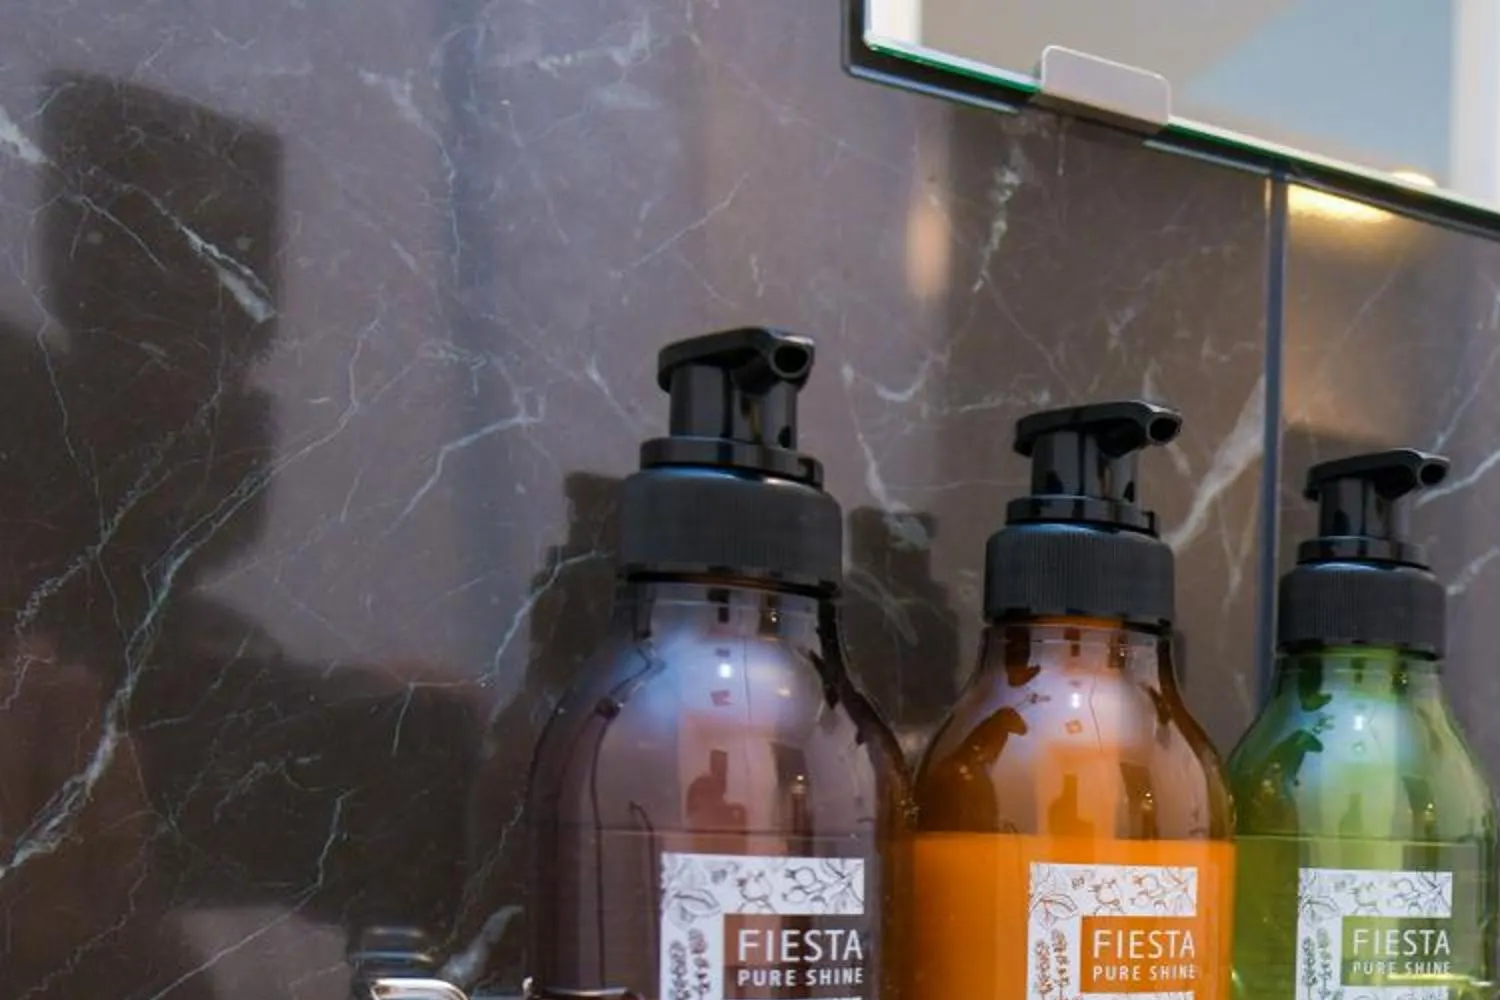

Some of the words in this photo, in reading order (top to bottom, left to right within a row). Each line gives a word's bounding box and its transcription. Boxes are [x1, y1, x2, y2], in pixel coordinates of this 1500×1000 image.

[737, 928, 864, 962] FIESTA
[1092, 928, 1196, 959] FIESTA
[1353, 928, 1451, 956] FIESTA
[737, 968, 796, 987] PURE
[805, 967, 865, 986] SHINE
[1092, 964, 1142, 981] PURE
[1149, 964, 1197, 981] SHINE
[1352, 960, 1397, 976] PURE
[1404, 961, 1451, 976] SHINE
